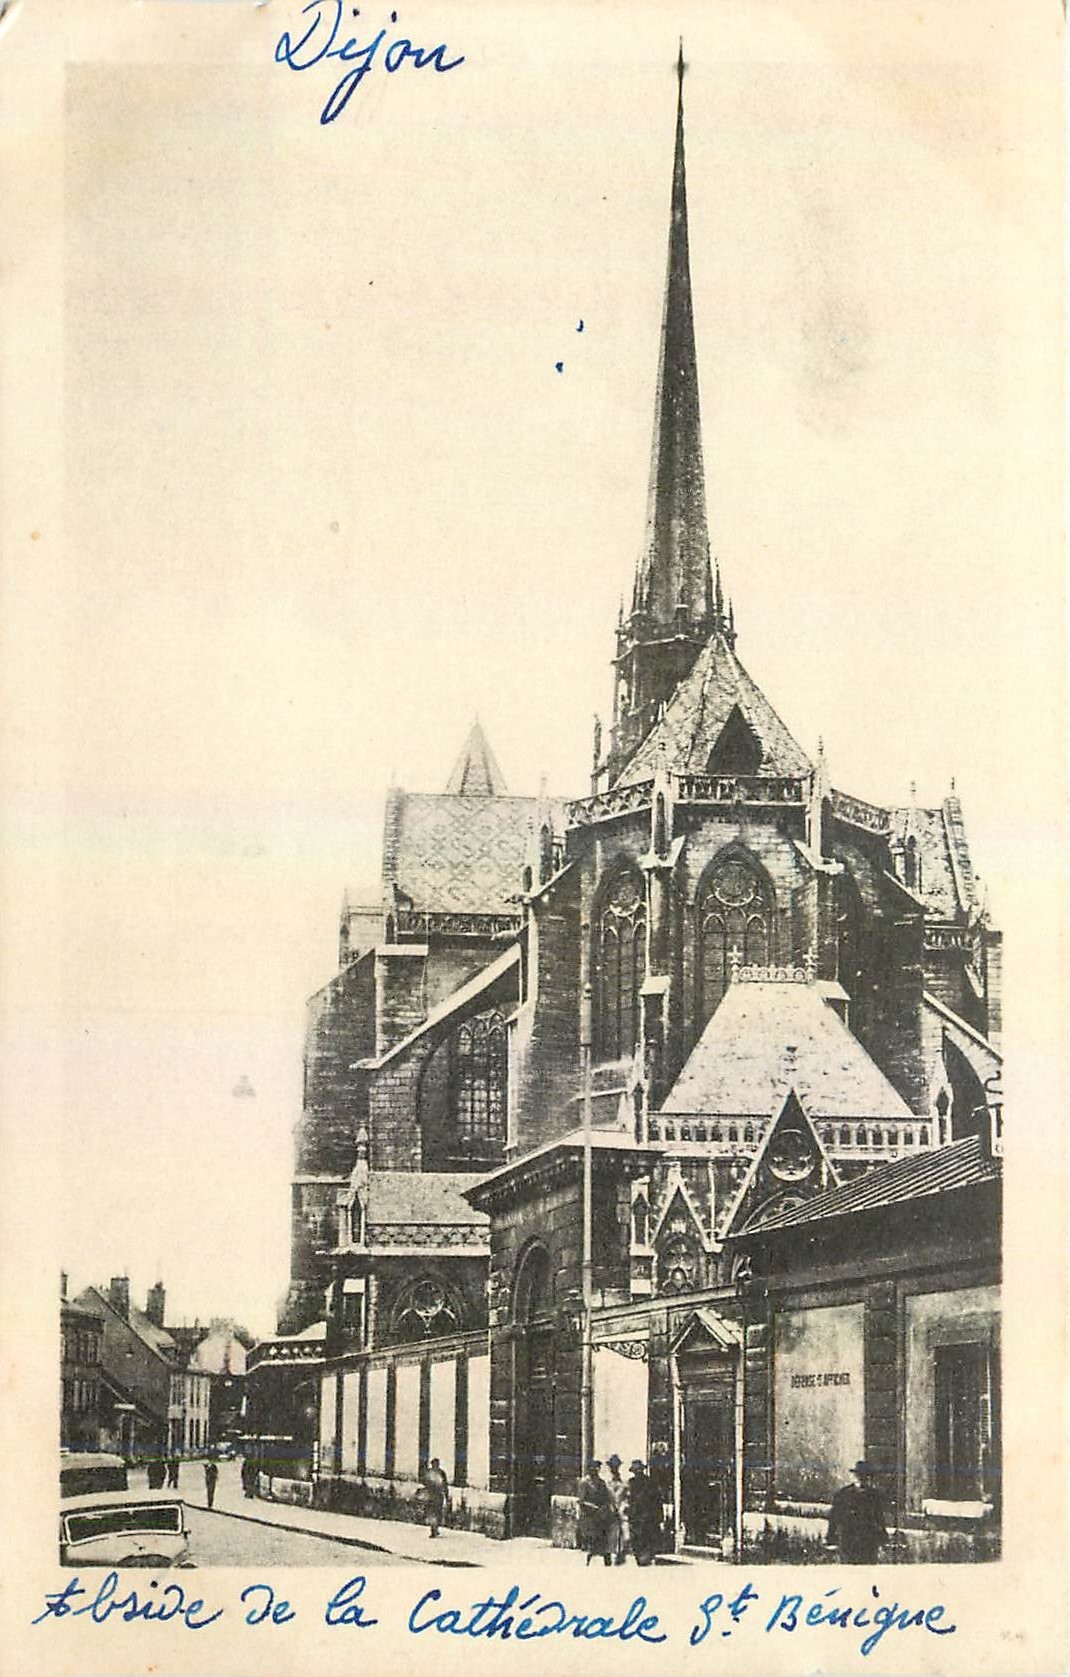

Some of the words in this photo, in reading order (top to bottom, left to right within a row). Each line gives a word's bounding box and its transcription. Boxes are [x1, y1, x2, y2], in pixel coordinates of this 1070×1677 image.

[275, 0, 464, 124] Dijon
[32, 1572, 223, 1629] Abside
[242, 1584, 295, 1626] de
[325, 1577, 378, 1628] la
[409, 1585, 667, 1643] Cathédrale
[766, 1586, 955, 1655] Bénigne
